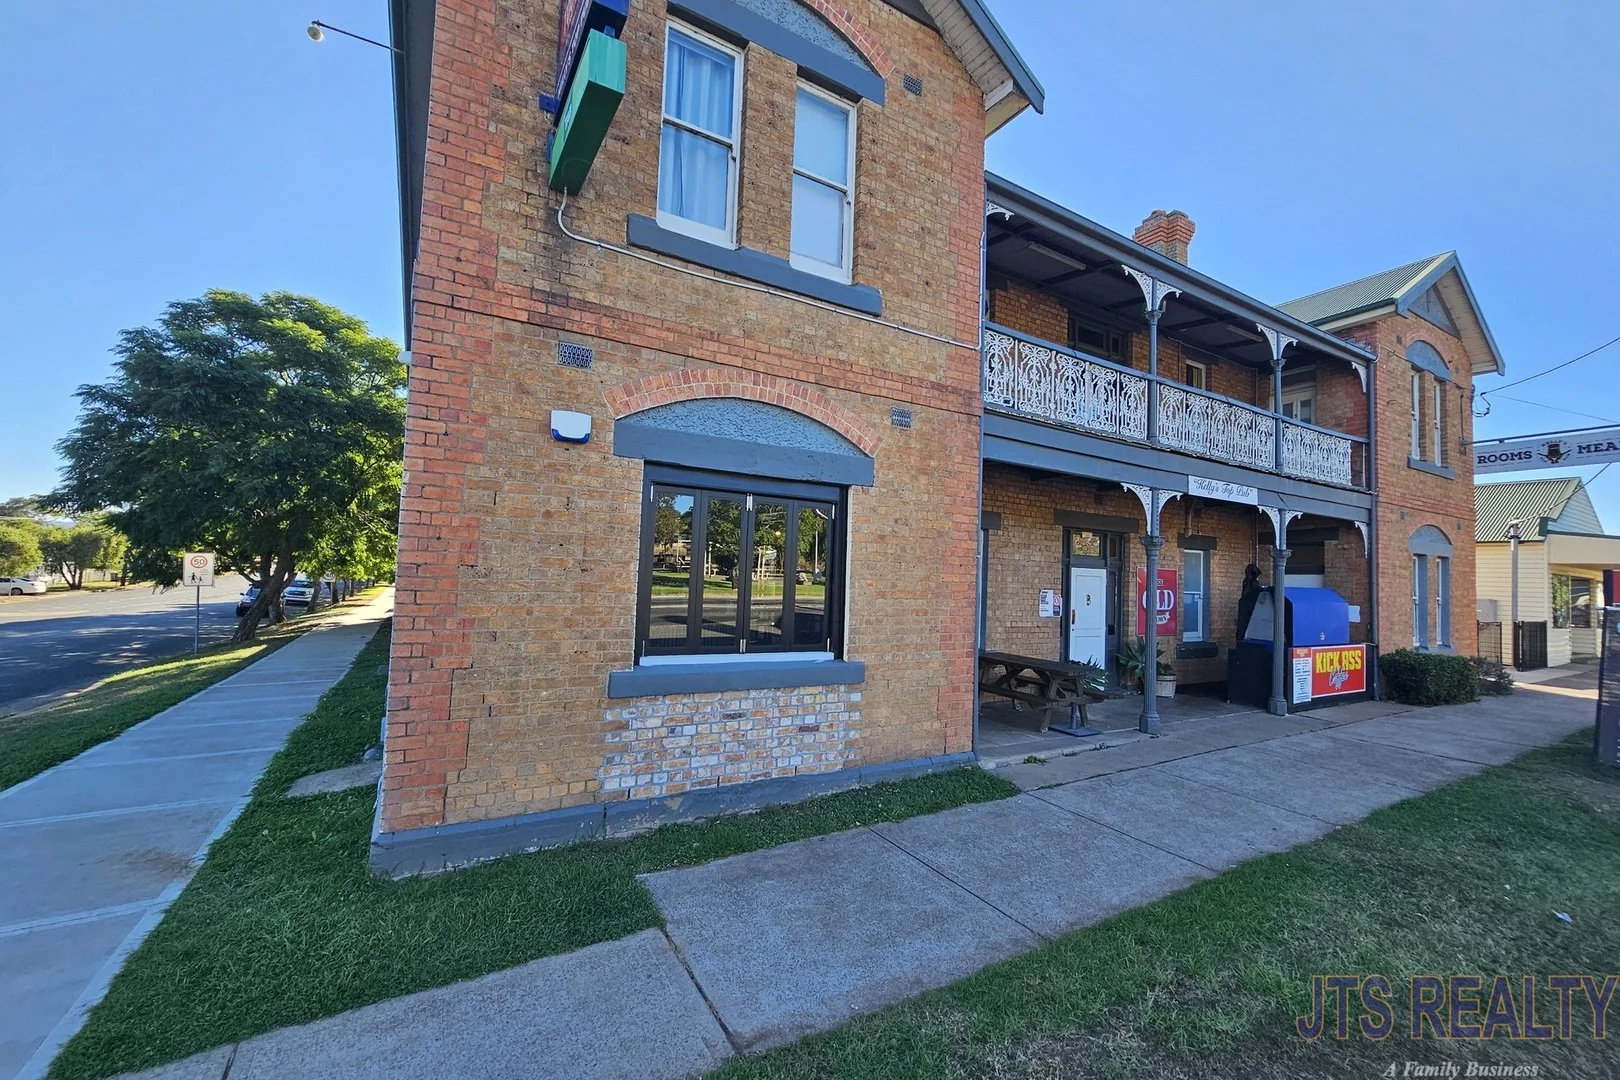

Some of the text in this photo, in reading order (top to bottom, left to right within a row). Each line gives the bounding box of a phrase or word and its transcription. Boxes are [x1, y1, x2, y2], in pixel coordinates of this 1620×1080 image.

[1477, 451, 1532, 464] ROOMS
[1577, 442, 1620, 454] MEA
[1222, 484, 1234, 498] Top
[193, 558, 205, 566] 50
[1142, 590, 1174, 610] LD
[1342, 650, 1361, 670] ASS
